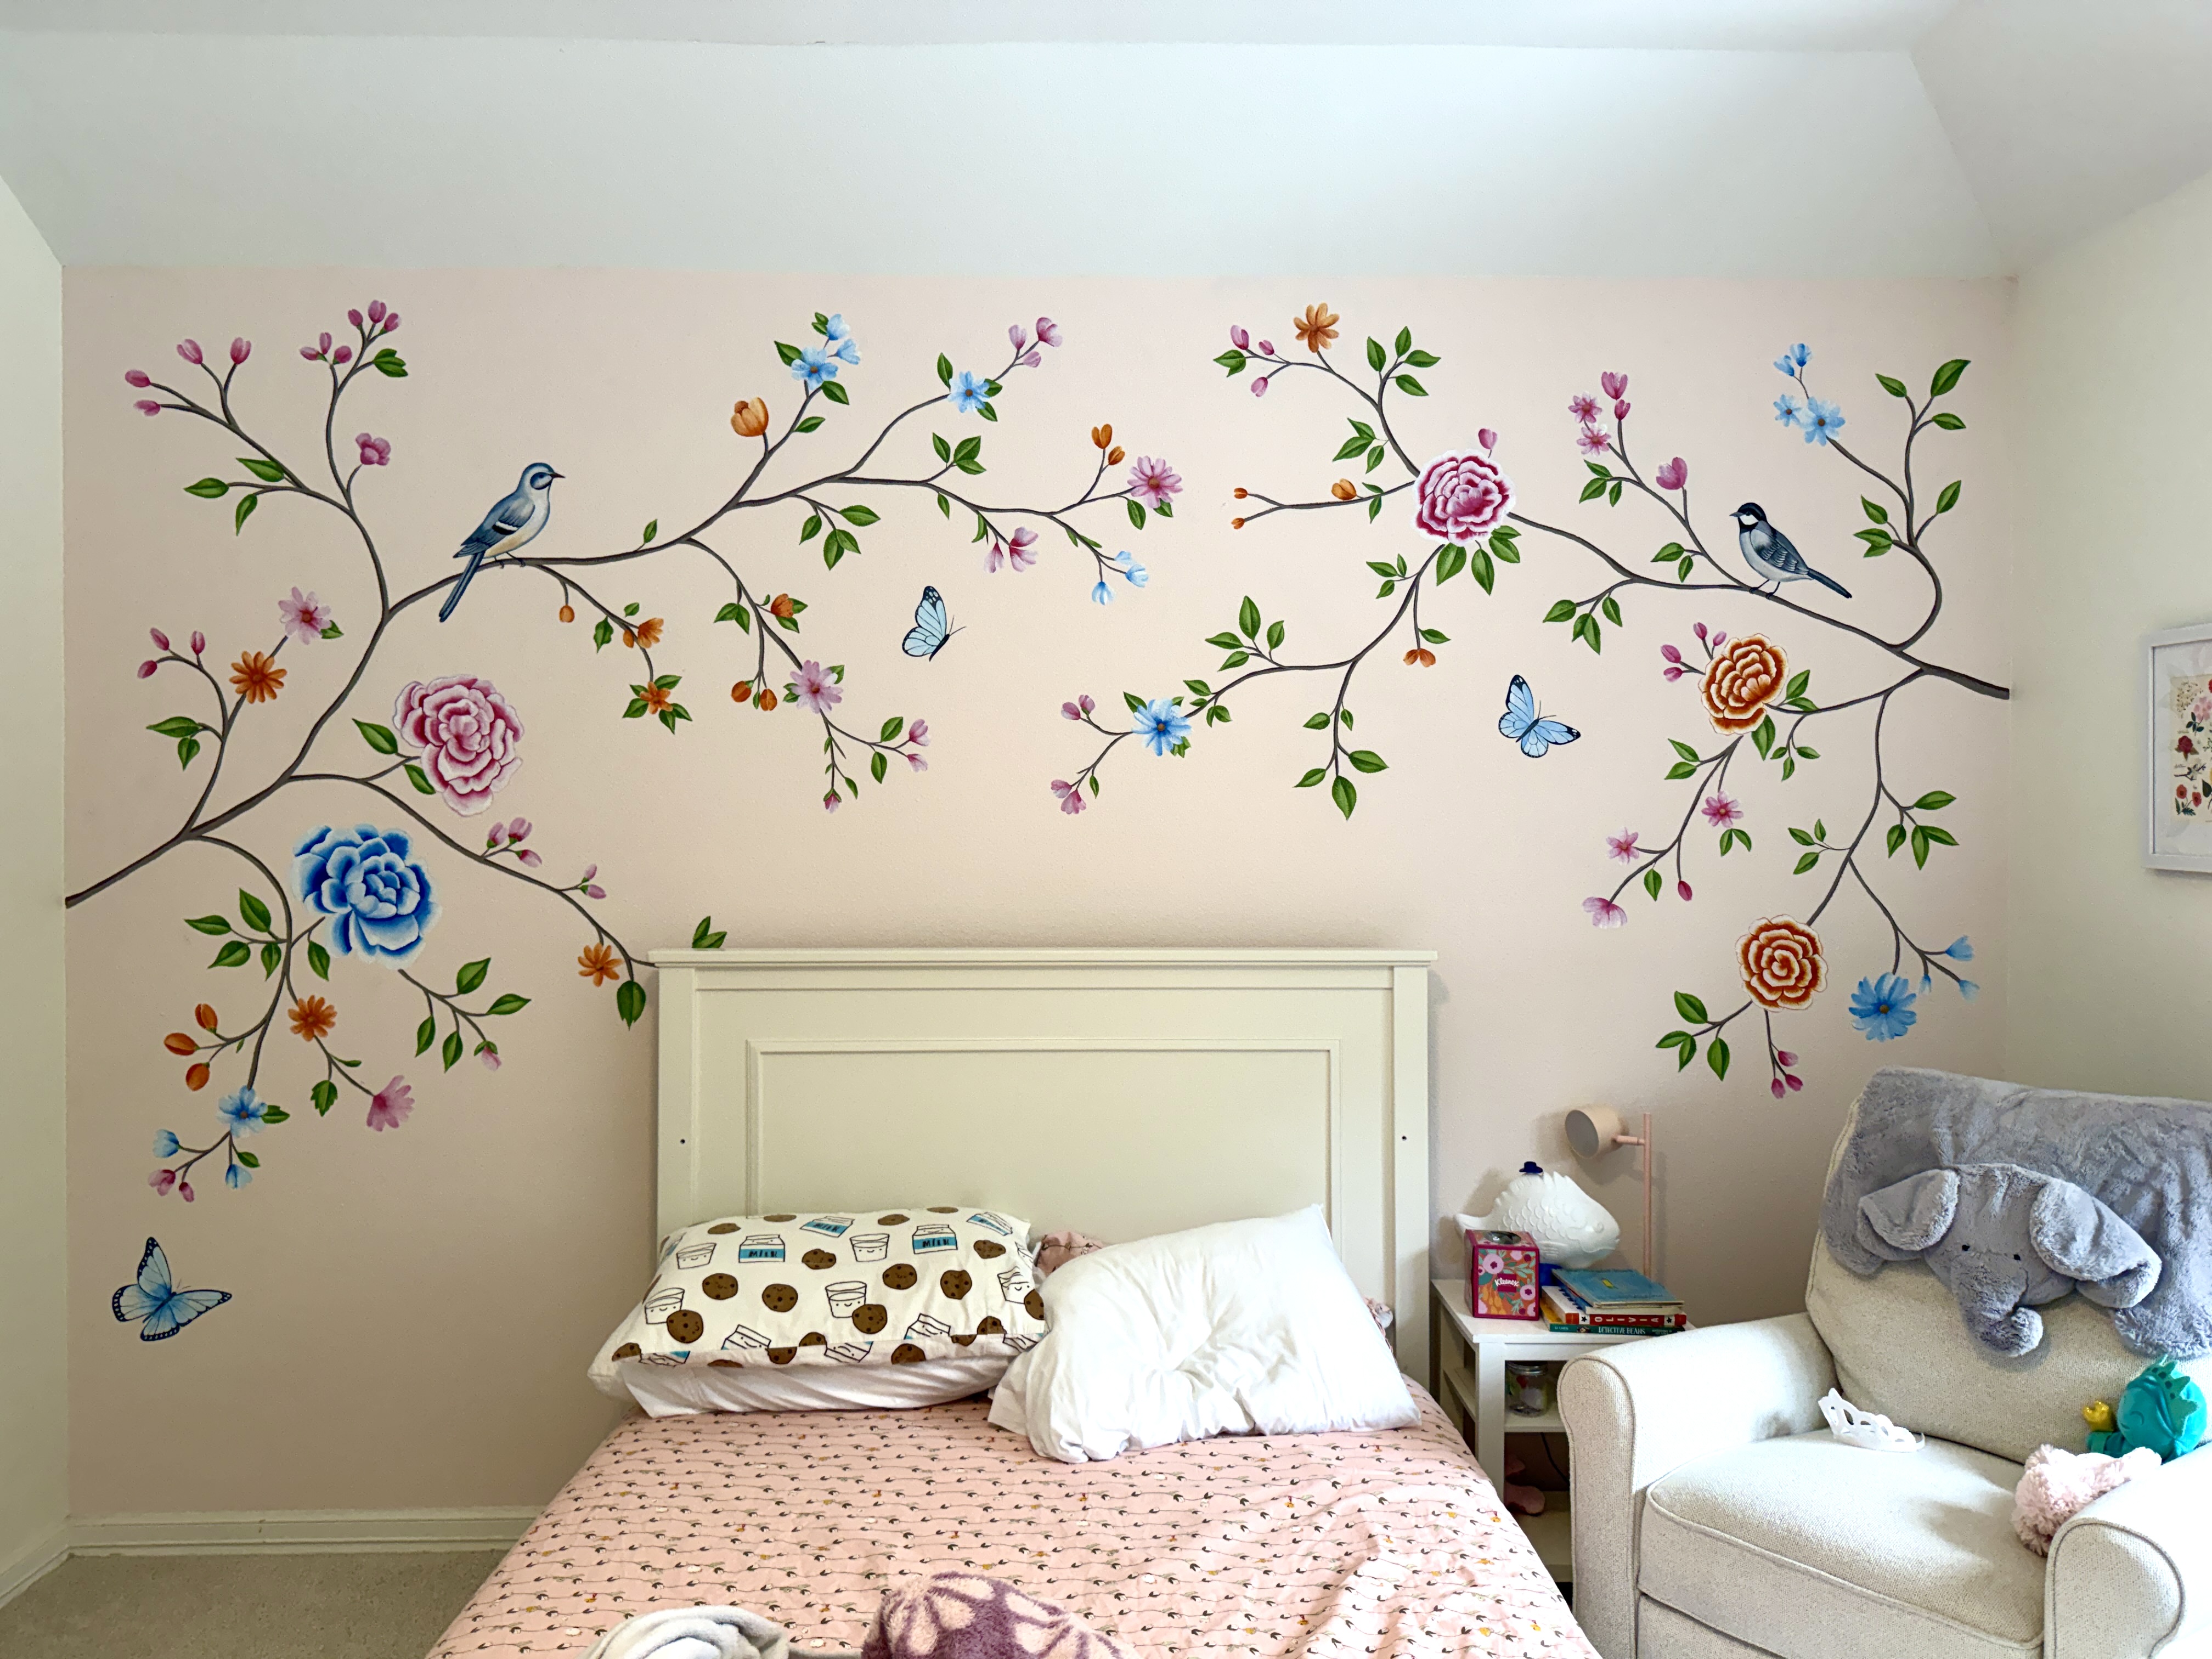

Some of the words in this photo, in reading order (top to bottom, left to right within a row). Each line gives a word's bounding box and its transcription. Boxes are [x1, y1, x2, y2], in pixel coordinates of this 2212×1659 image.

[922, 1238, 950, 1248] MILK
[1494, 1277, 1519, 1286] Kleenex
[1598, 1326, 1626, 1334] DETECTIVE
